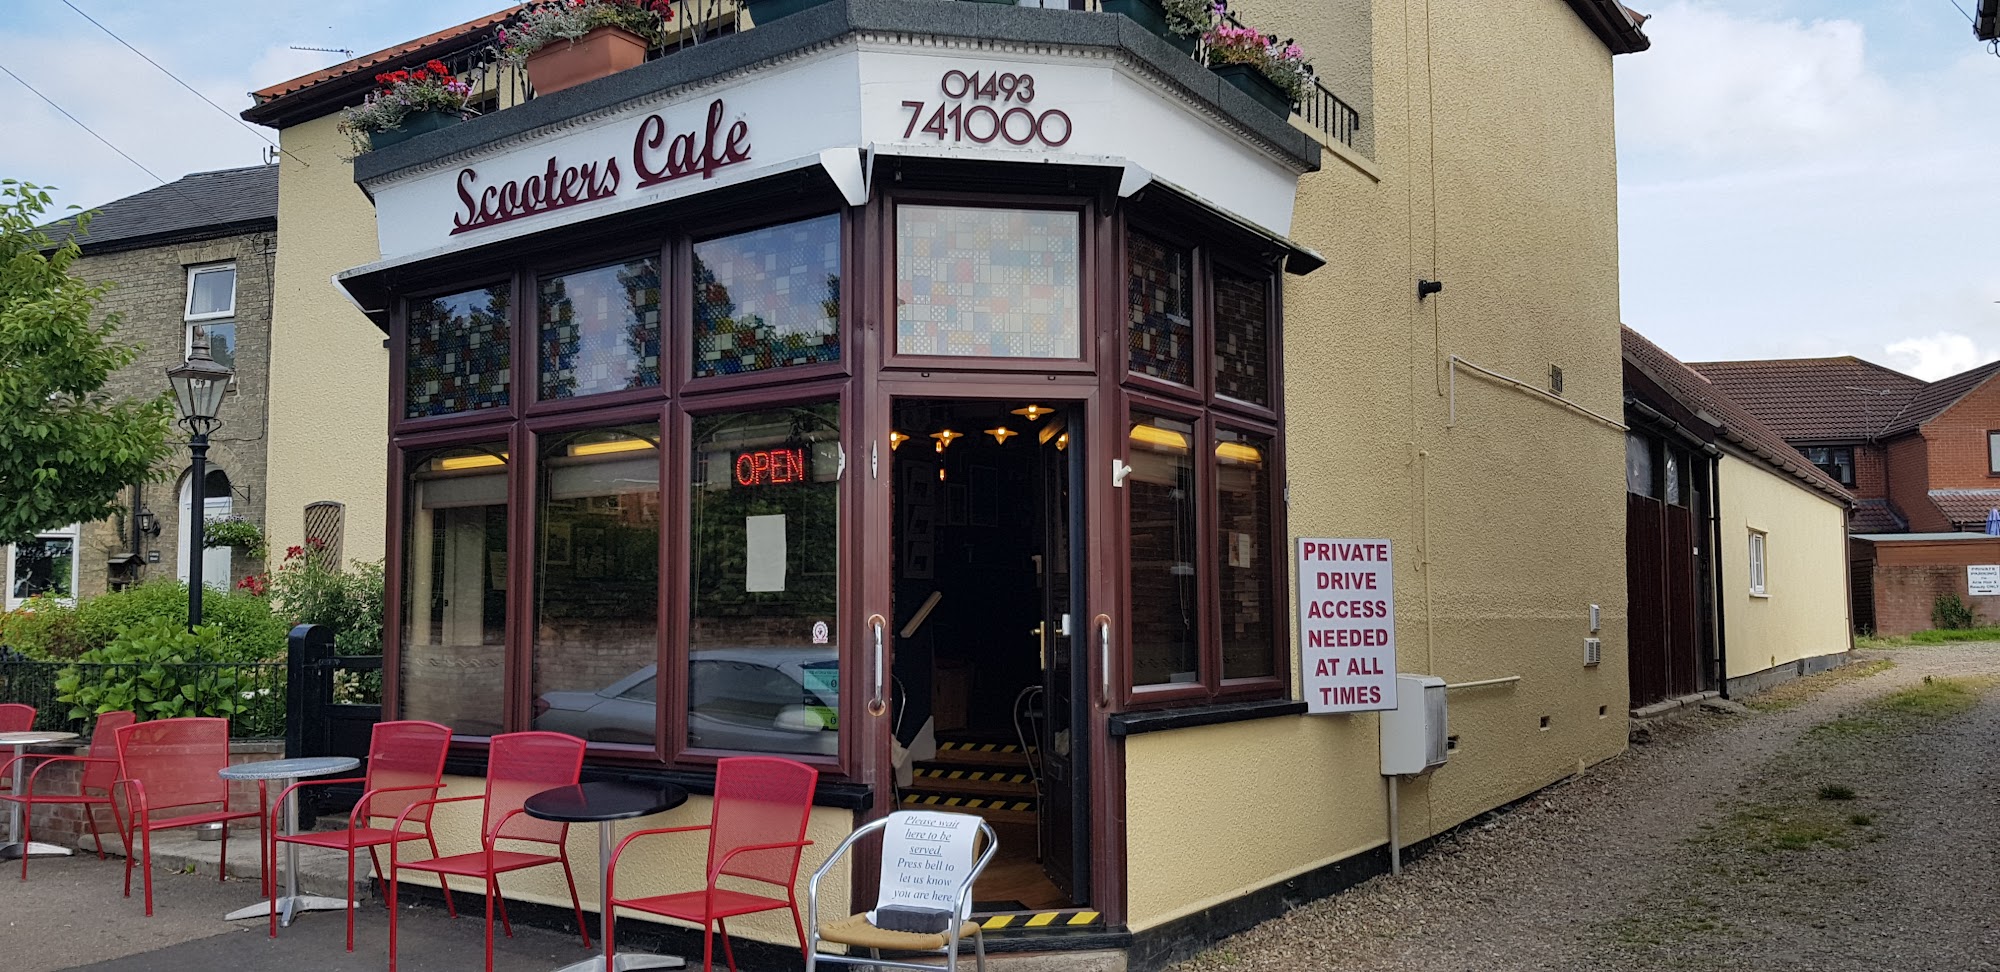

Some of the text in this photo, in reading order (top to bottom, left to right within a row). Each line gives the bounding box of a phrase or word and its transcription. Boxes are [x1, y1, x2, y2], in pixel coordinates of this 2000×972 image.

[941, 69, 1035, 104] 01493
[901, 100, 1072, 147] 741000
[449, 98, 752, 236] Scooters Cafe
[736, 449, 803, 486] OPEN
[1303, 542, 1388, 562] PRIVATE
[1316, 572, 1377, 590] DRIVE
[1307, 600, 1387, 619] ACCESS
[1308, 629, 1388, 648] NEEDED
[1315, 657, 1384, 677] AT ALL
[1319, 686, 1381, 706] TIMES
[904, 815, 960, 829] Please wait
[905, 828, 952, 842] here to be
[897, 857, 955, 872] Press bell to
[899, 873, 952, 886] let us know
[892, 889, 954, 902] you are here.
